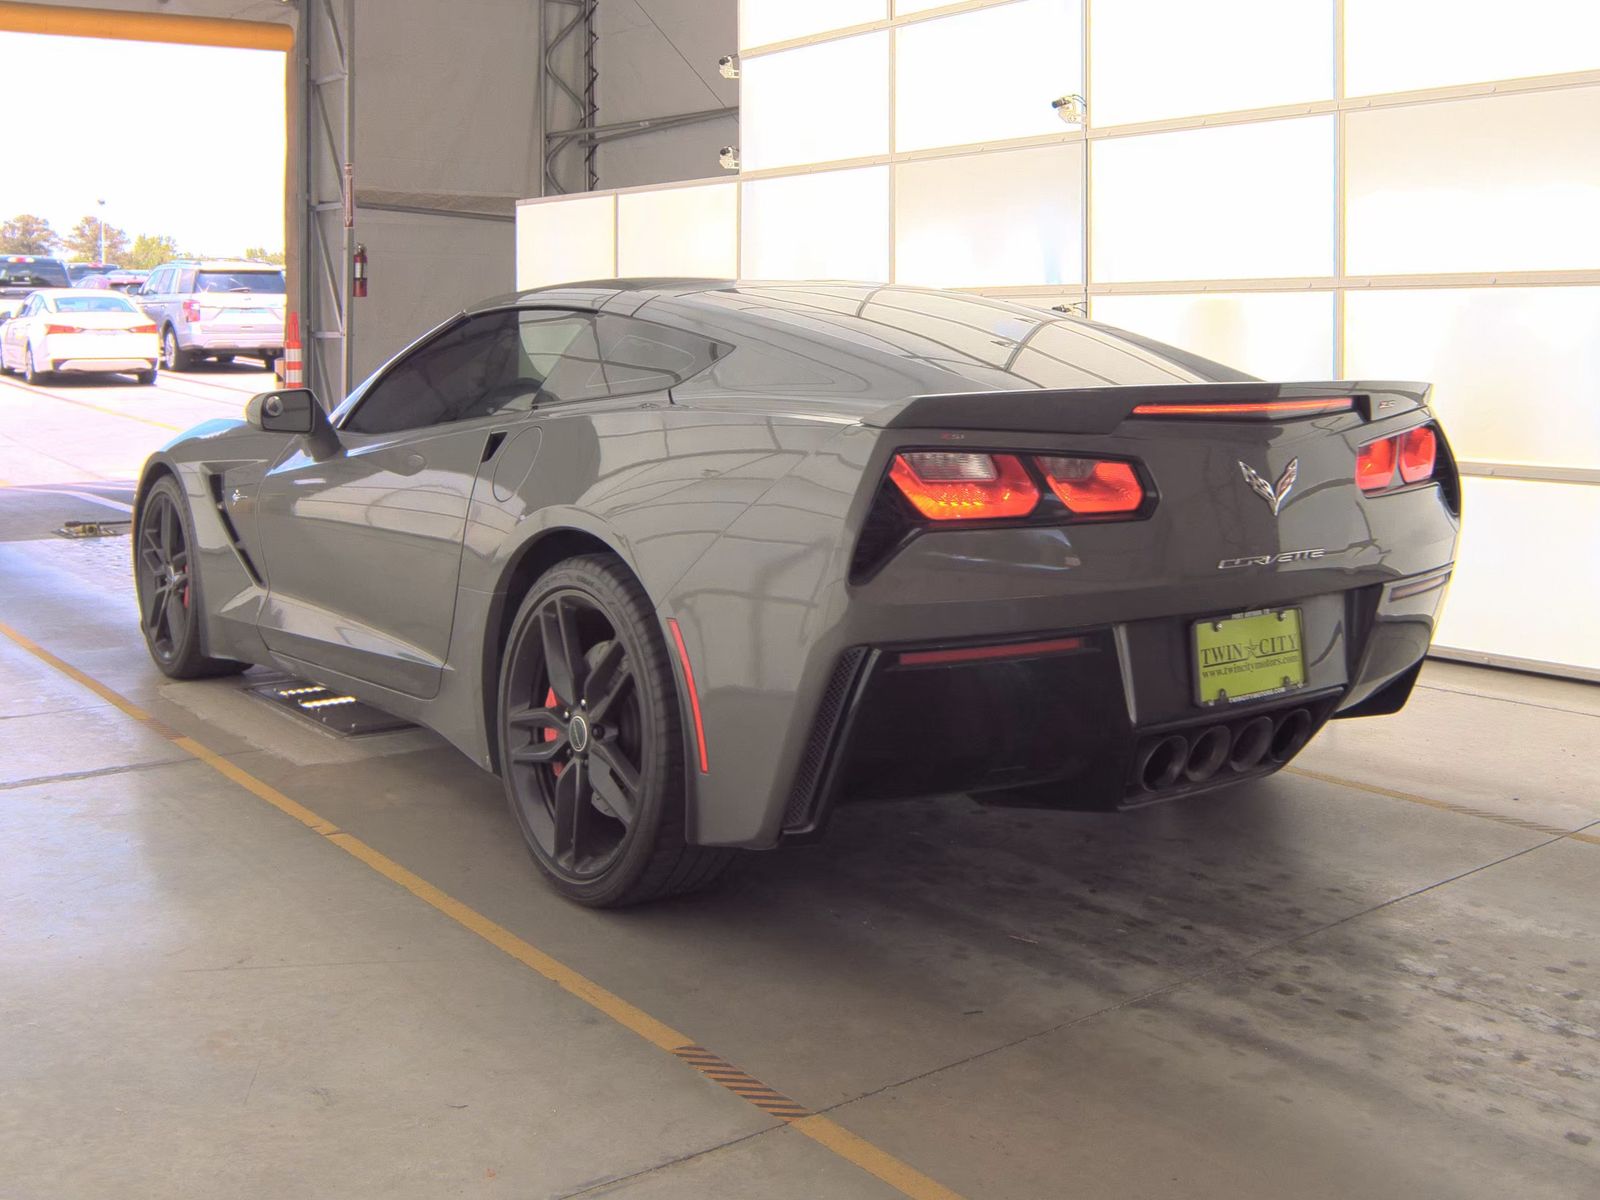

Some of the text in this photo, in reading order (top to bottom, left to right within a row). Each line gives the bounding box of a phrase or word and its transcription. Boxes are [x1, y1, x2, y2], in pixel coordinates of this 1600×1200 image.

[1218, 548, 1326, 569] CORVETTE
[1200, 634, 1298, 666] TWIN CITY
